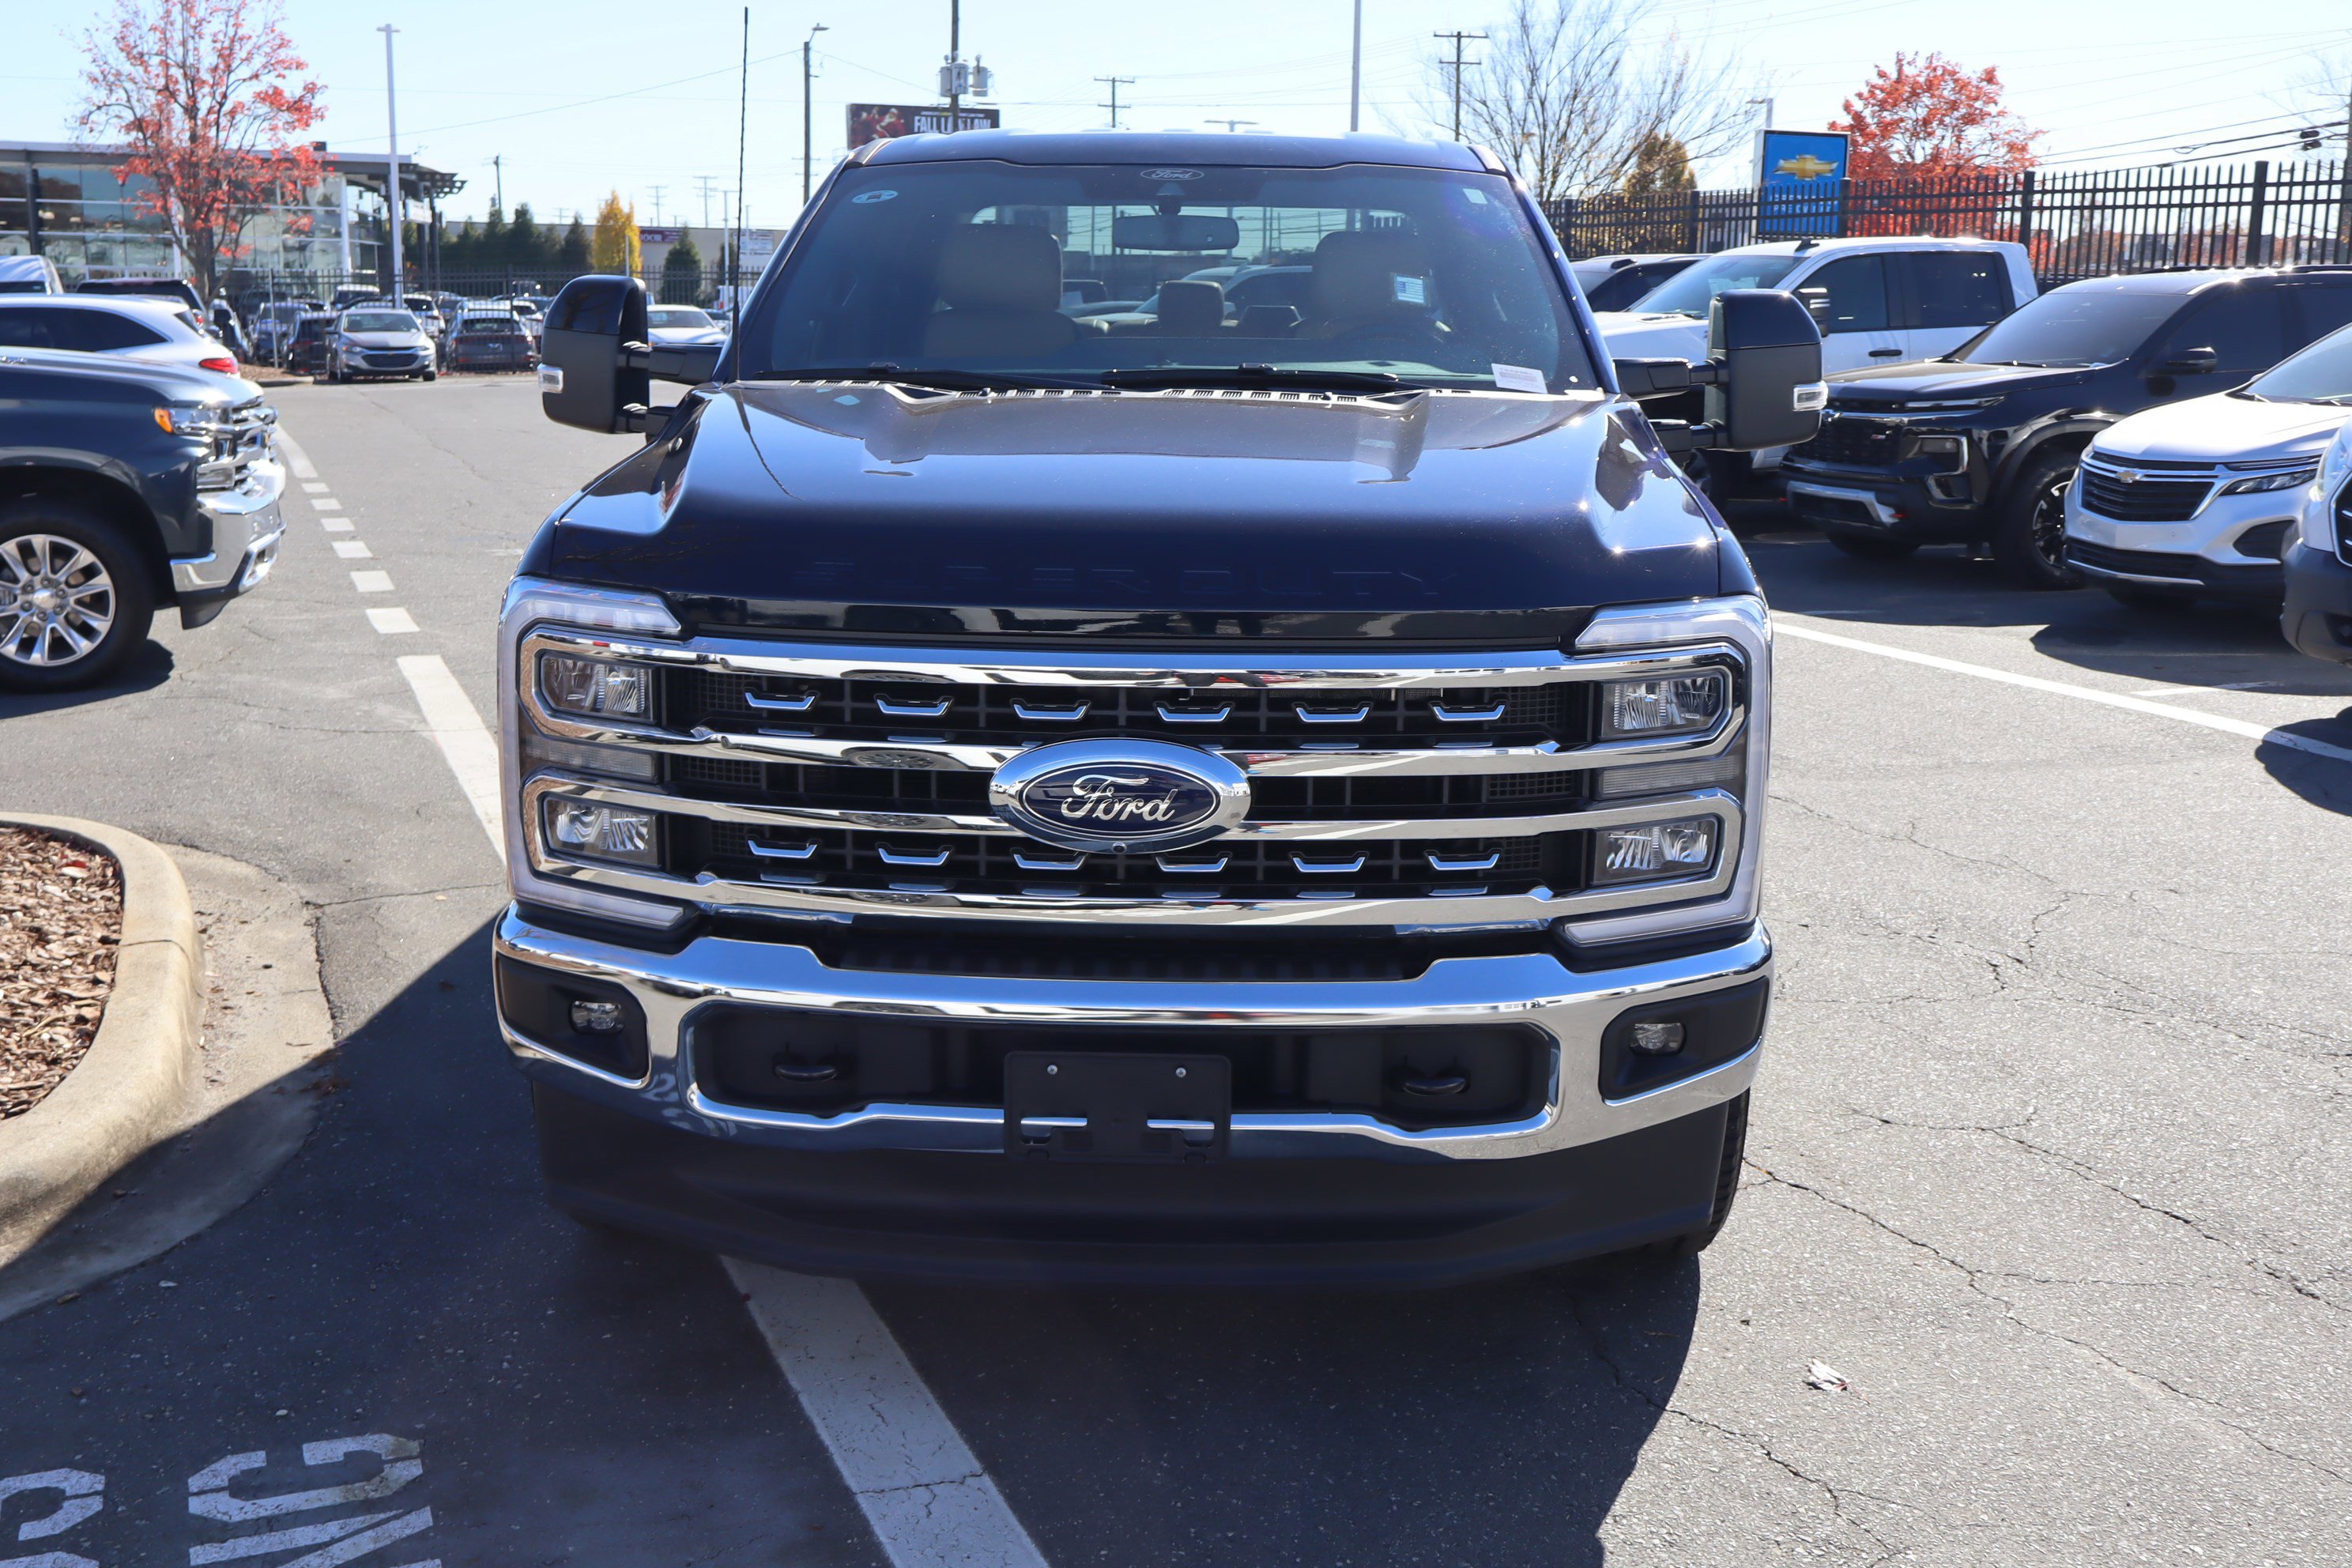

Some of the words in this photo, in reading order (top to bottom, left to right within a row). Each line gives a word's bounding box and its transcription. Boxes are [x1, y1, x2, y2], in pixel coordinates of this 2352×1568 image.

[914, 115, 939, 134] FALL
[1152, 169, 1193, 179] Ford
[1180, 569, 1461, 595] DUTY
[1061, 774, 1178, 821] Ford
